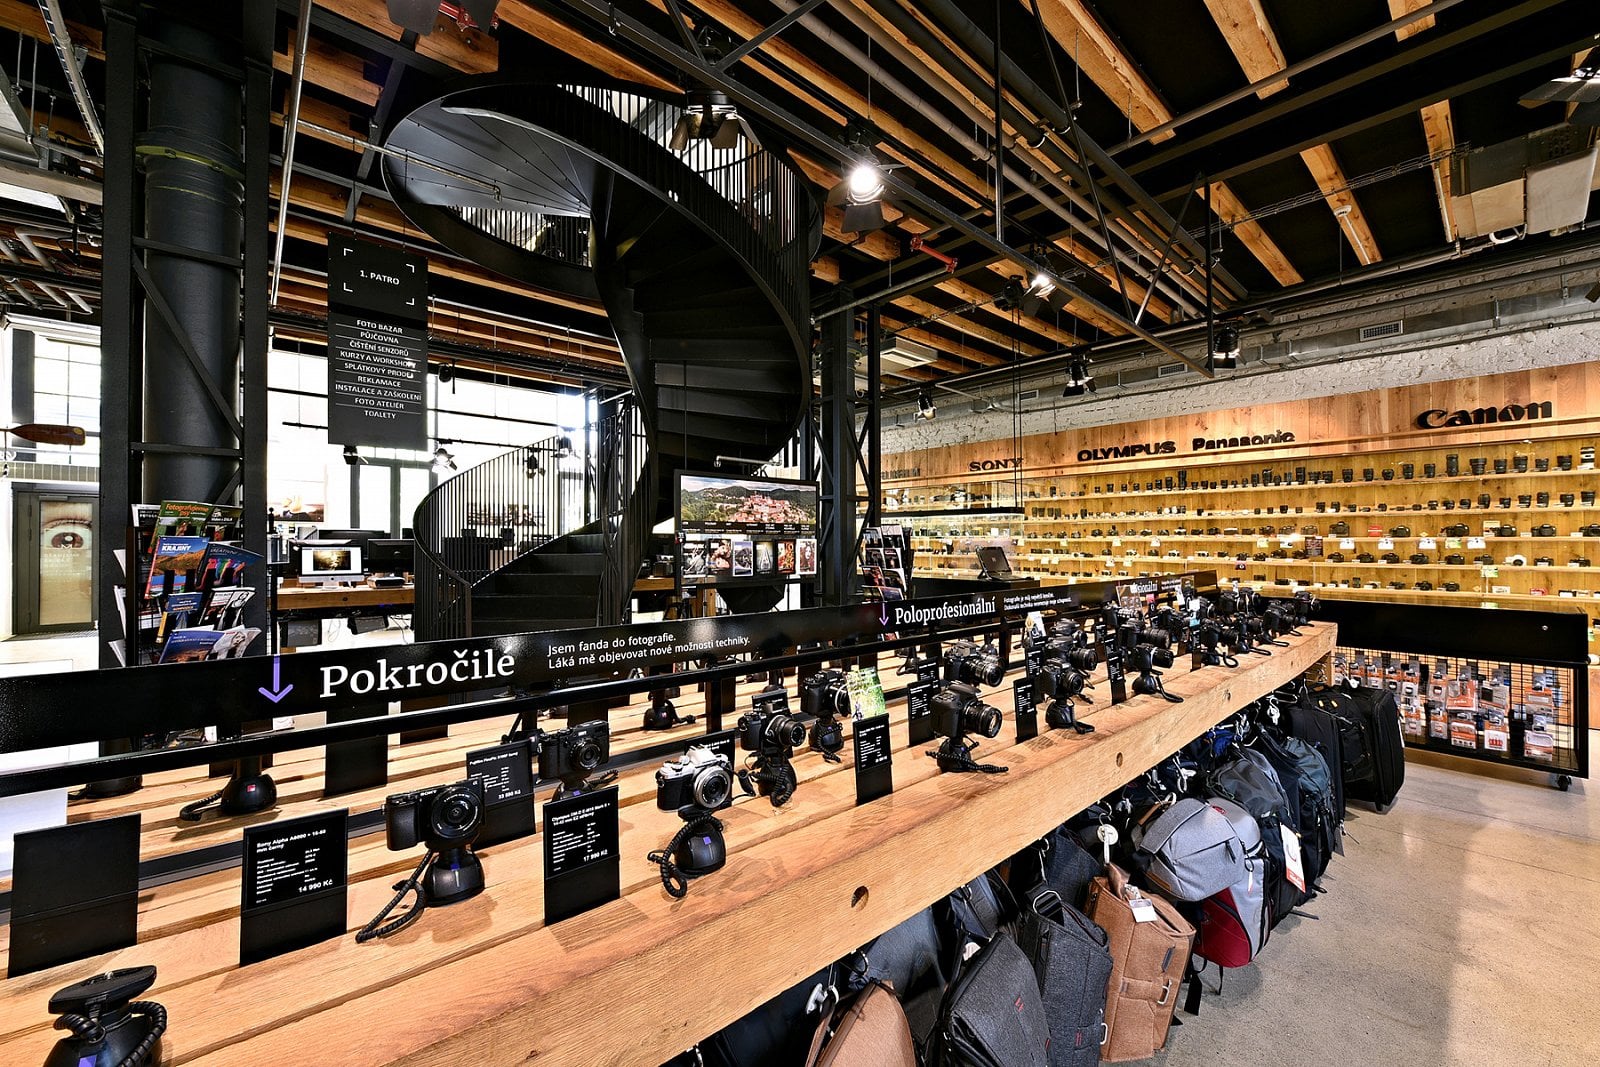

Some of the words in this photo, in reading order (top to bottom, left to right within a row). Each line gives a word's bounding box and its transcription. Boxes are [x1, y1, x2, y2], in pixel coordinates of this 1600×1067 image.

[360, 270, 368, 278] 1.
[370, 272, 400, 285] PATRO
[357, 320, 377, 329] FOTO
[378, 324, 403, 334] BAZAR
[360, 330, 399, 344] PŮJČOVNA
[349, 339, 377, 351] ČIŠTĚNÍ
[377, 343, 409, 357] SENZORŮ
[340, 351, 365, 361] KURZY
[372, 356, 417, 369] WORKSHOPY
[344, 362, 386, 375] SPLÁTKOVÝ
[387, 369, 414, 379] PRODEJ
[357, 375, 401, 388] REKLAMACE
[335, 384, 375, 396] INSTALACE
[382, 389, 421, 401] ZAŠKOLENÍ
[355, 397, 374, 406] FOTO
[376, 400, 404, 410] ATELIÉR
[364, 410, 396, 420] TOALETY
[1415, 401, 1552, 430] Canon
[1193, 430, 1295, 451] Panasonic
[1077, 441, 1176, 461] OLYMPUS
[969, 457, 1024, 472] SONY
[895, 596, 996, 625] Poloprofesionální
[547, 644, 575, 658] Jsem
[579, 640, 609, 652] fanda
[613, 638, 625, 648] do
[628, 632, 677, 648] fotografie.
[548, 653, 575, 669] Láká
[579, 651, 595, 665] mě
[598, 648, 648, 664] objevovat
[650, 644, 672, 656] nové
[675, 639, 714, 653] možnosti
[716, 634, 751, 649] techniky.
[320, 649, 515, 699] Pokročilé
[257, 841, 271, 849] Sony
[272, 837, 289, 845] Alpha
[268, 843, 285, 851] černý
[299, 885, 307, 893] 14
[322, 878, 333, 887] Kč
